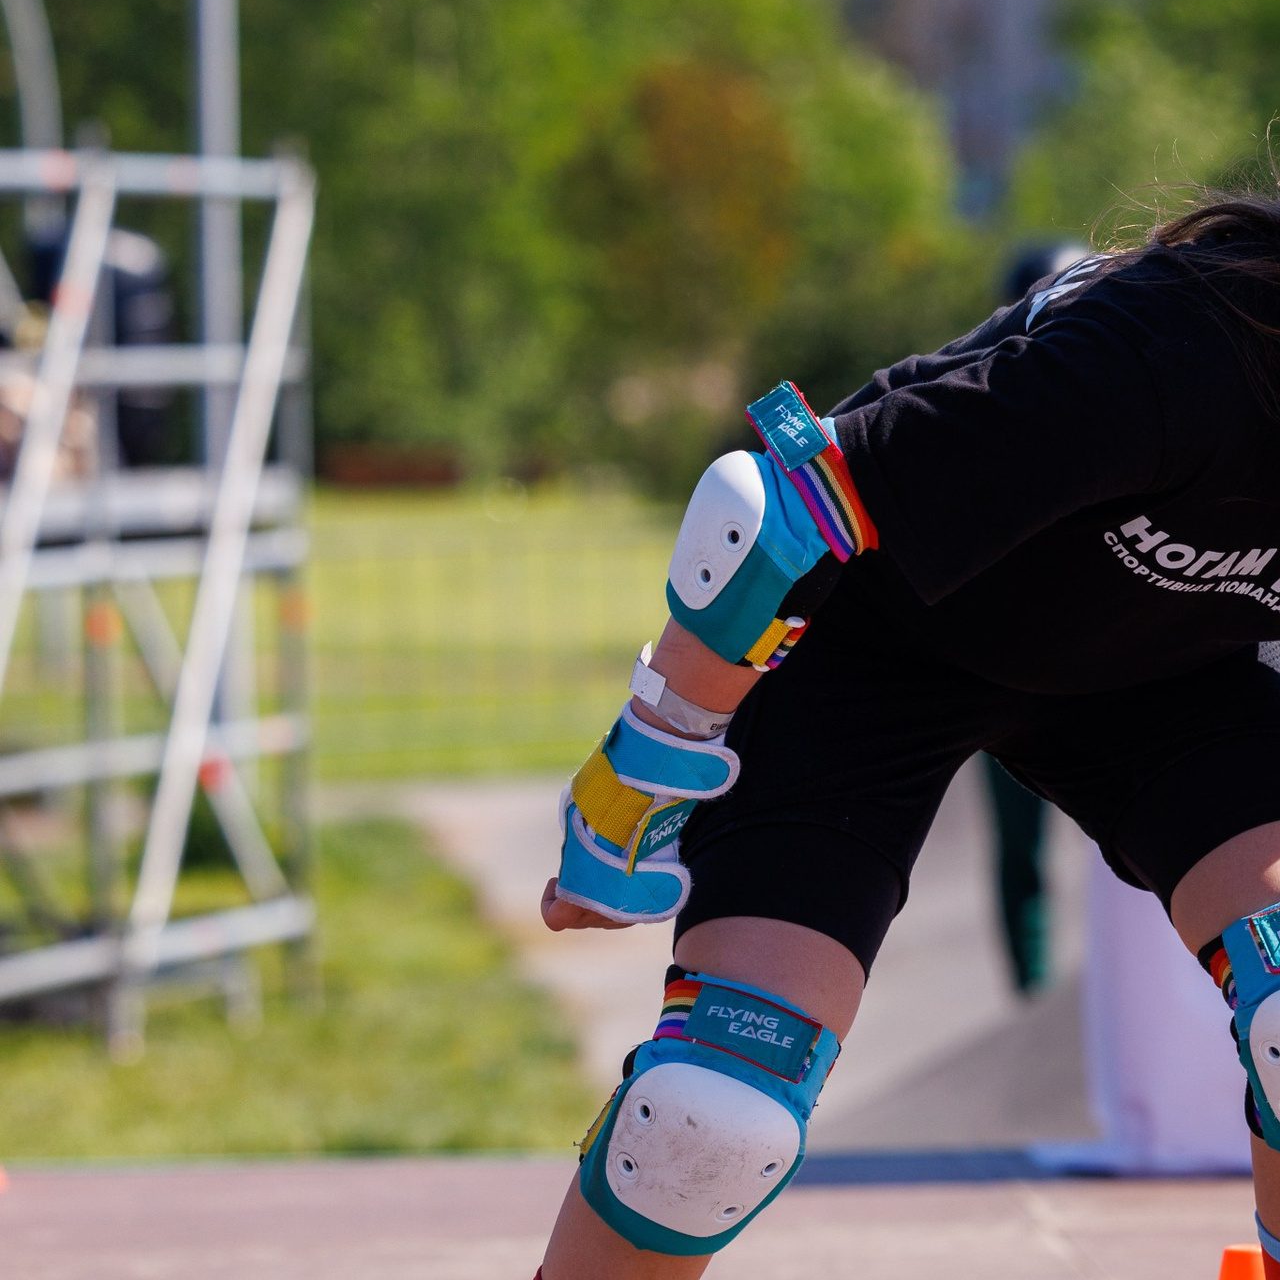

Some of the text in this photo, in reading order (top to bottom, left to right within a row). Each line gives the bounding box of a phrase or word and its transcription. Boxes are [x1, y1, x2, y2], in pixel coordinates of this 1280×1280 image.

[1103, 531, 1215, 592] СПОРТИВНАЯ
[1120, 515, 1278, 579] НОГАМ
[706, 1005, 780, 1030] FLYING
[727, 1021, 795, 1049] EAGLE
